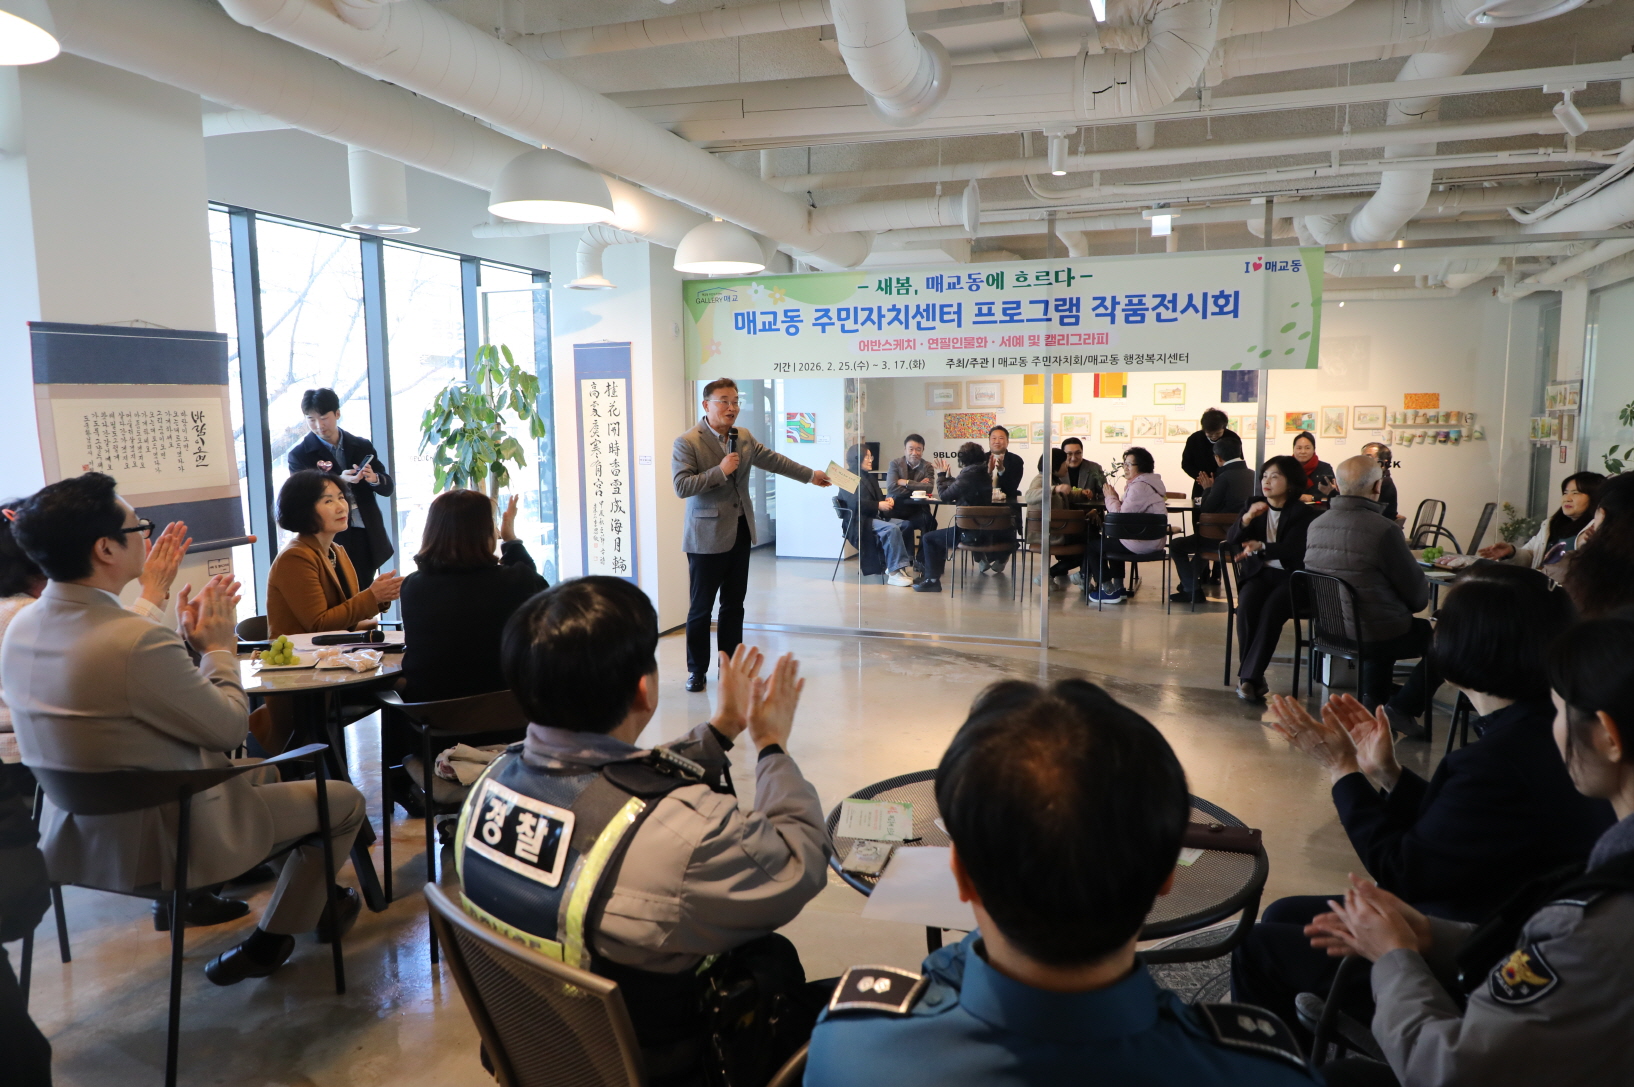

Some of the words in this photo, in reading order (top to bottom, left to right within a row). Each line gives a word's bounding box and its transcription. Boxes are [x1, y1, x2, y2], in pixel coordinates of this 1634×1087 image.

[1265, 260, 1302, 273] 매교동
[875, 276, 918, 296] 새봄,
[925, 271, 1005, 293] 매교동에
[1012, 267, 1075, 289] 흐르다
[734, 308, 804, 337] 매교동
[811, 302, 963, 334] 주민자치센터
[972, 296, 1081, 327] 프로그램
[1091, 289, 1240, 325] 작품전시회
[858, 338, 917, 352] 어반스케치
[927, 335, 988, 350] 연필인물화
[999, 334, 1024, 348] 서예
[1028, 334, 1041, 347] 및
[1044, 332, 1109, 348] 캘리그라피
[773, 362, 791, 373] 기간
[798, 361, 826, 372] 2026.
[827, 361, 836, 371] 2.
[838, 360, 870, 372] 25.(수)
[882, 360, 891, 370] 3.
[893, 359, 926, 370] 17.(화)
[946, 357, 990, 369] 주최/주관
[998, 356, 1028, 367] 매교동
[1031, 353, 1120, 367] 주민자치회/매교동
[1123, 352, 1190, 365] 행정복지센터
[933, 451, 963, 459] 9BLOC
[482, 797, 549, 864] 경찰
